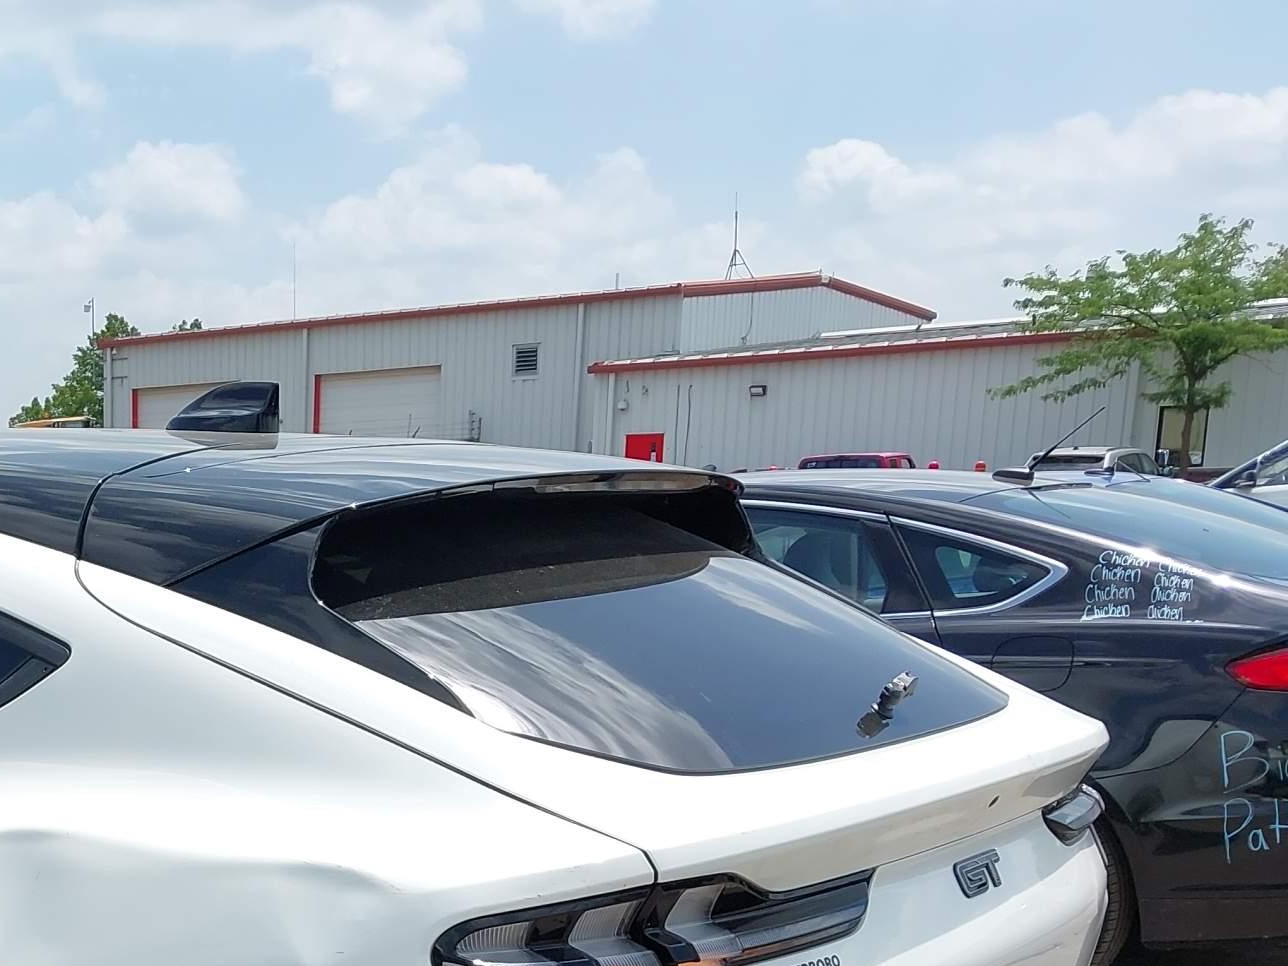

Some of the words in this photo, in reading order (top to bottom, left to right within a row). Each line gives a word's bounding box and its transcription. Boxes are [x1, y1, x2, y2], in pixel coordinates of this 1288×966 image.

[1099, 550, 1150, 568] Chicken
[1090, 564, 1141, 583] Chicken
[1154, 572, 1194, 591] Chicken
[1085, 583, 1135, 604] Chicken
[1083, 602, 1130, 618] Chicken
[953, 848, 1002, 899] GT
